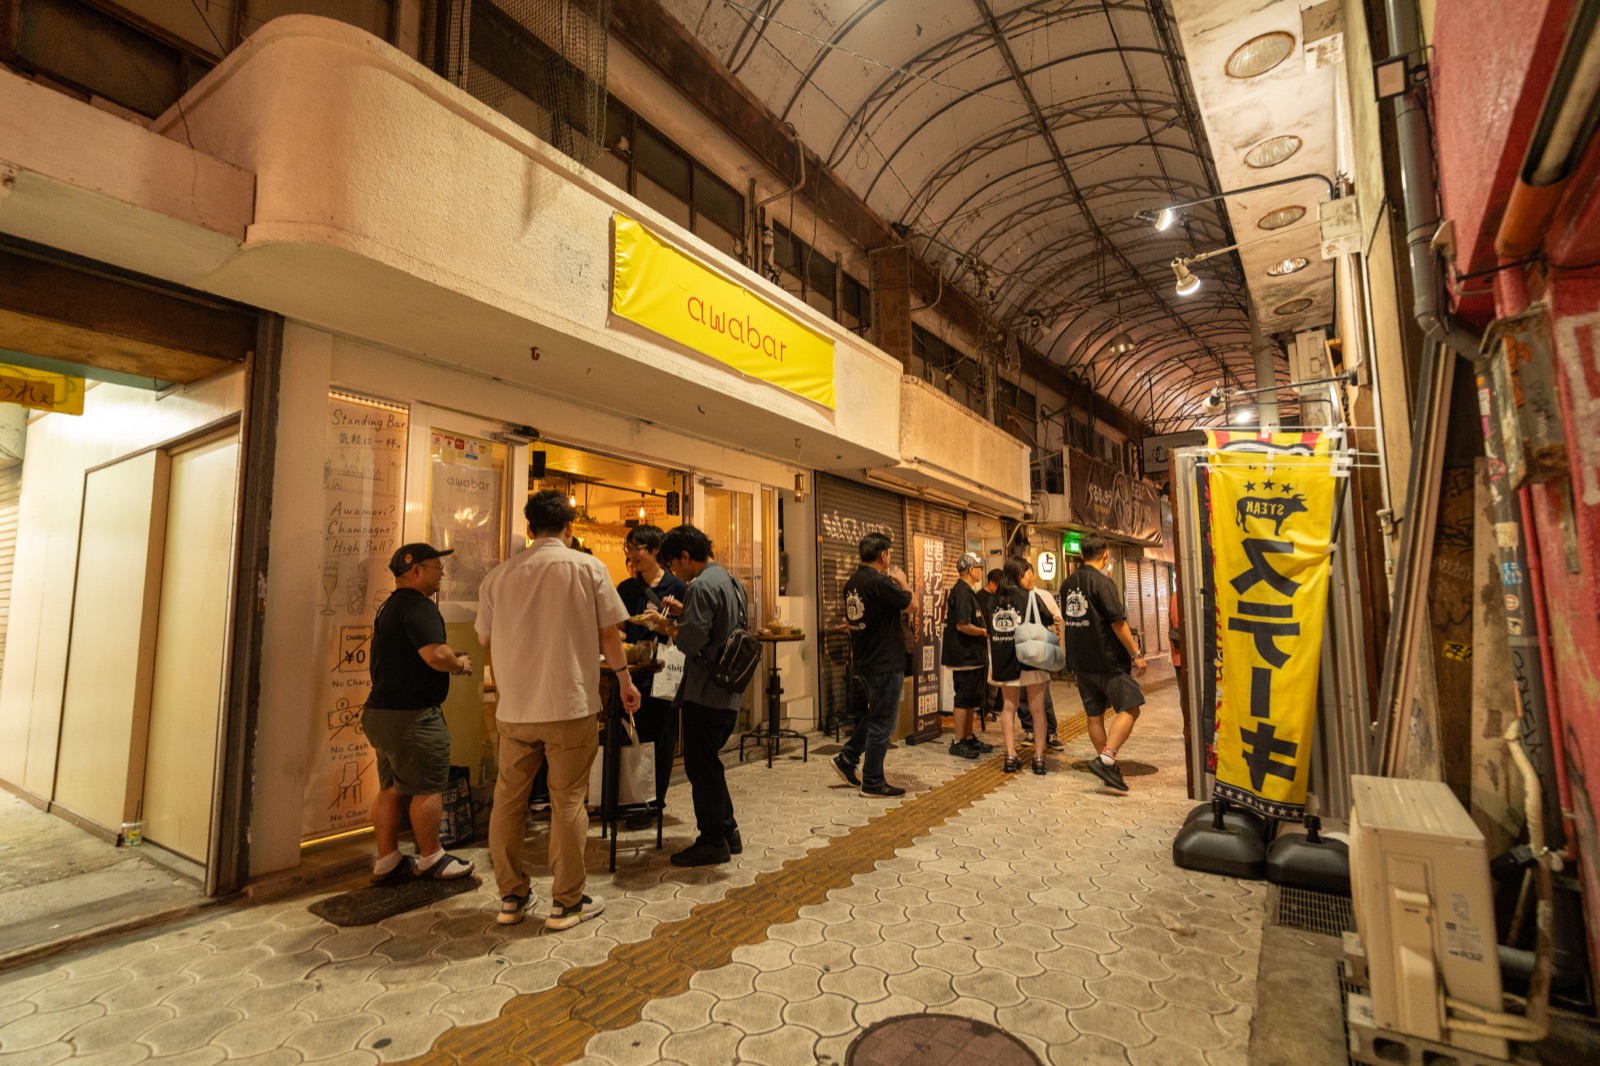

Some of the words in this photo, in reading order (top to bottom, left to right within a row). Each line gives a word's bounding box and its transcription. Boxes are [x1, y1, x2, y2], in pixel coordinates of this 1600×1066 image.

[687, 295, 787, 363] awabar
[331, 409, 383, 431] Standing
[446, 475, 490, 492] awabar
[330, 500, 396, 518] Awamori?
[327, 519, 398, 537] Champagne?
[332, 539, 359, 556] High
[364, 538, 395, 553] Ball?
[345, 649, 366, 664] ¥0
[332, 679, 344, 688] No
[346, 678, 371, 687] Charg
[330, 746, 344, 755] No
[347, 742, 369, 752] Cash
[330, 813, 343, 823] No
[345, 807, 368, 819] Chair
